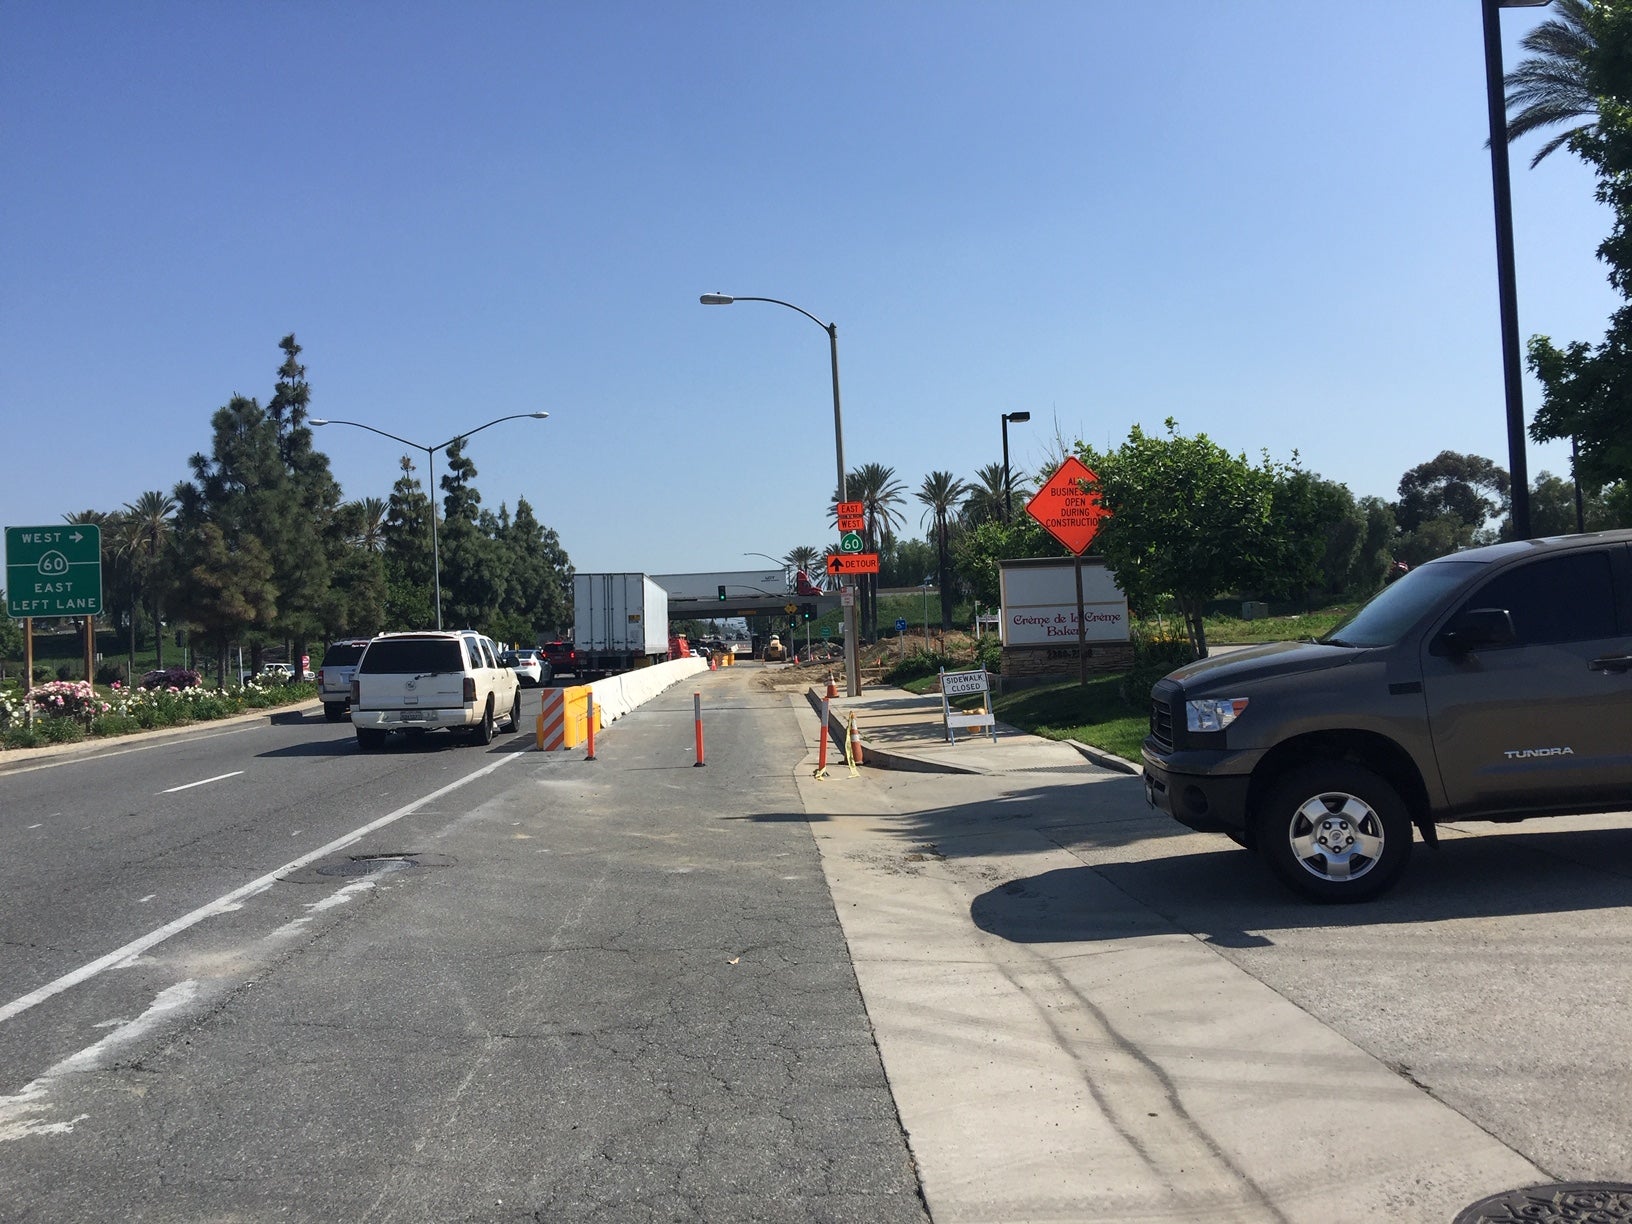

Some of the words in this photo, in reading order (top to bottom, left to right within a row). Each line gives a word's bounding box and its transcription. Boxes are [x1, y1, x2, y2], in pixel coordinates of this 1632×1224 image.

[1050, 486, 1099, 497] BUSINESES
[1064, 498, 1086, 507] OPEN
[841, 504, 859, 513] EAST
[1061, 508, 1090, 517] DURING
[841, 520, 861, 529] WEST
[1045, 517, 1102, 528] CONSTRUCTIO
[21, 532, 62, 544] WEST
[844, 539, 859, 550] 60
[43, 557, 64, 571] 60
[845, 559, 876, 569] DETOUR
[34, 582, 73, 593] EAST
[12, 599, 49, 611] LEFT
[56, 597, 96, 609] LANE
[1013, 614, 1050, 627] Crème
[1054, 613, 1067, 624] de
[1084, 611, 1121, 624] Crème
[946, 674, 983, 685] SIDEWALK
[951, 683, 981, 692] CLOSED
[1503, 746, 1574, 759] TUNDRA
